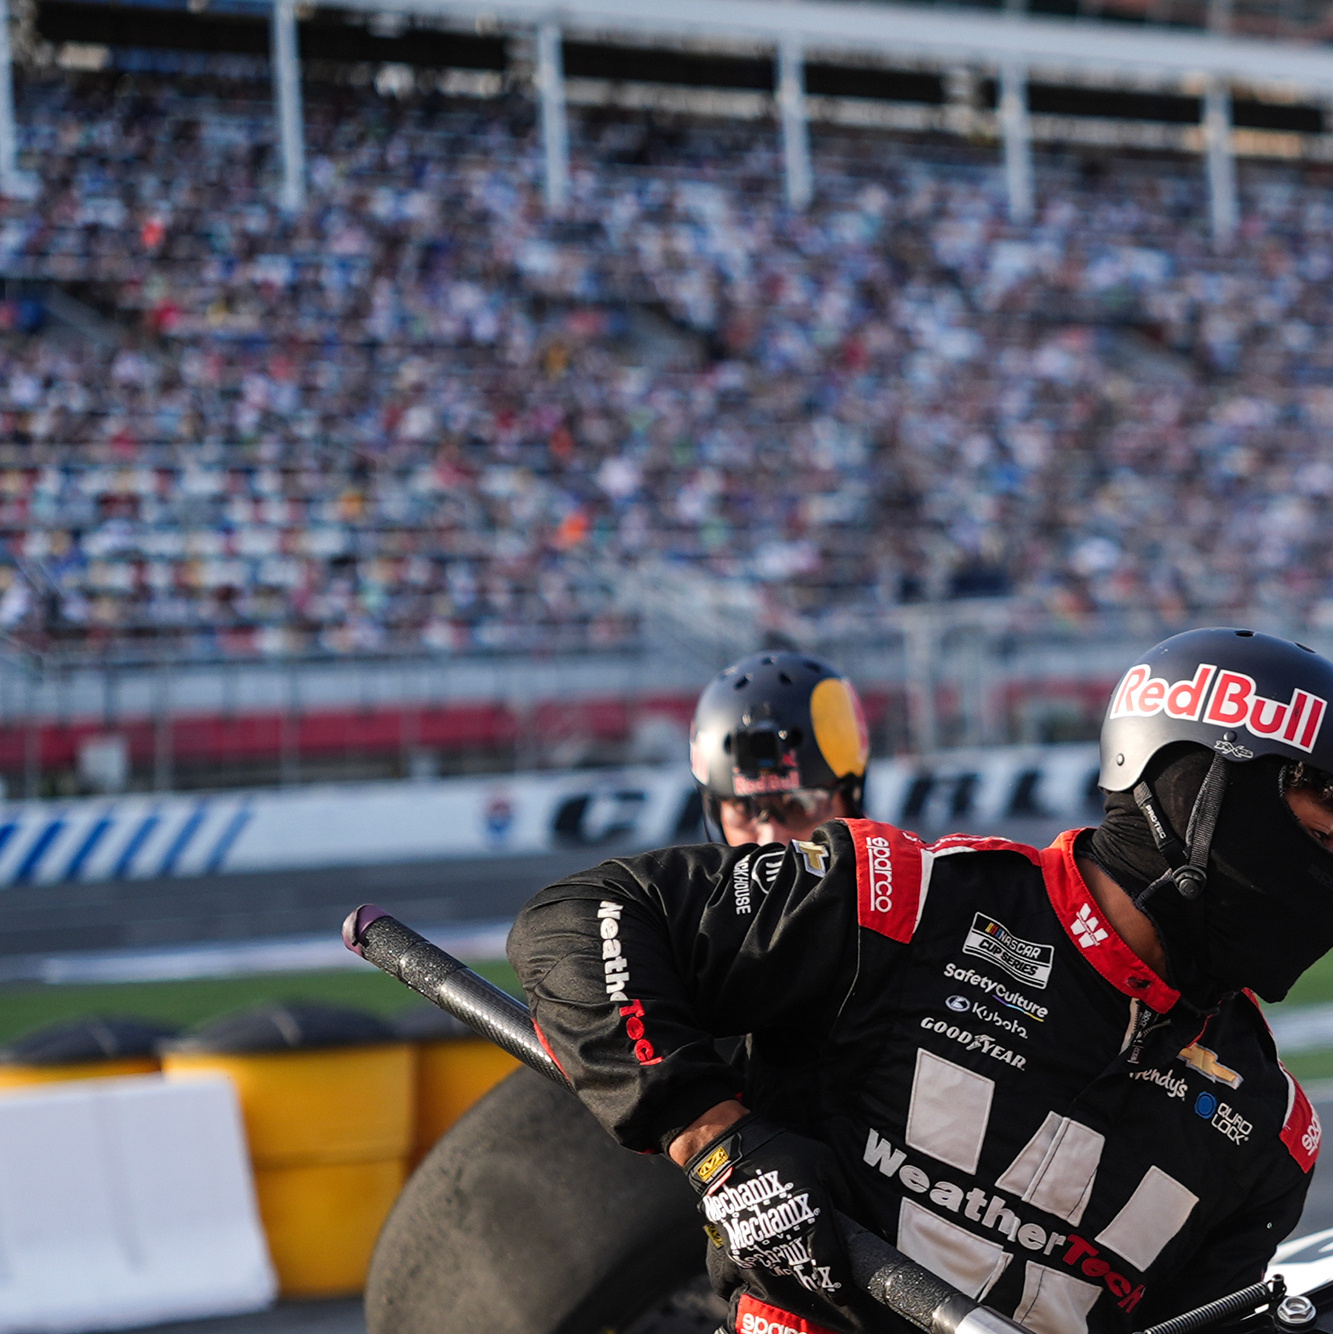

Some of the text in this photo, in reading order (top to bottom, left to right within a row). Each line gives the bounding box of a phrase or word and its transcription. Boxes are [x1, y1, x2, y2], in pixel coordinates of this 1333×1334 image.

[1110, 664, 1327, 754] Red Bull
[978, 938, 1039, 976] CUP SERIES
[999, 930, 1042, 959] NASCAR
[943, 962, 1049, 1019] SafetyCulture
[972, 1002, 1028, 1039] Kubota
[919, 1016, 1027, 1071] GOODYEAR
[1129, 1068, 1189, 1101] endy's
[1211, 1113, 1246, 1146] LOCK
[863, 1128, 1146, 1314] WeatherTech
